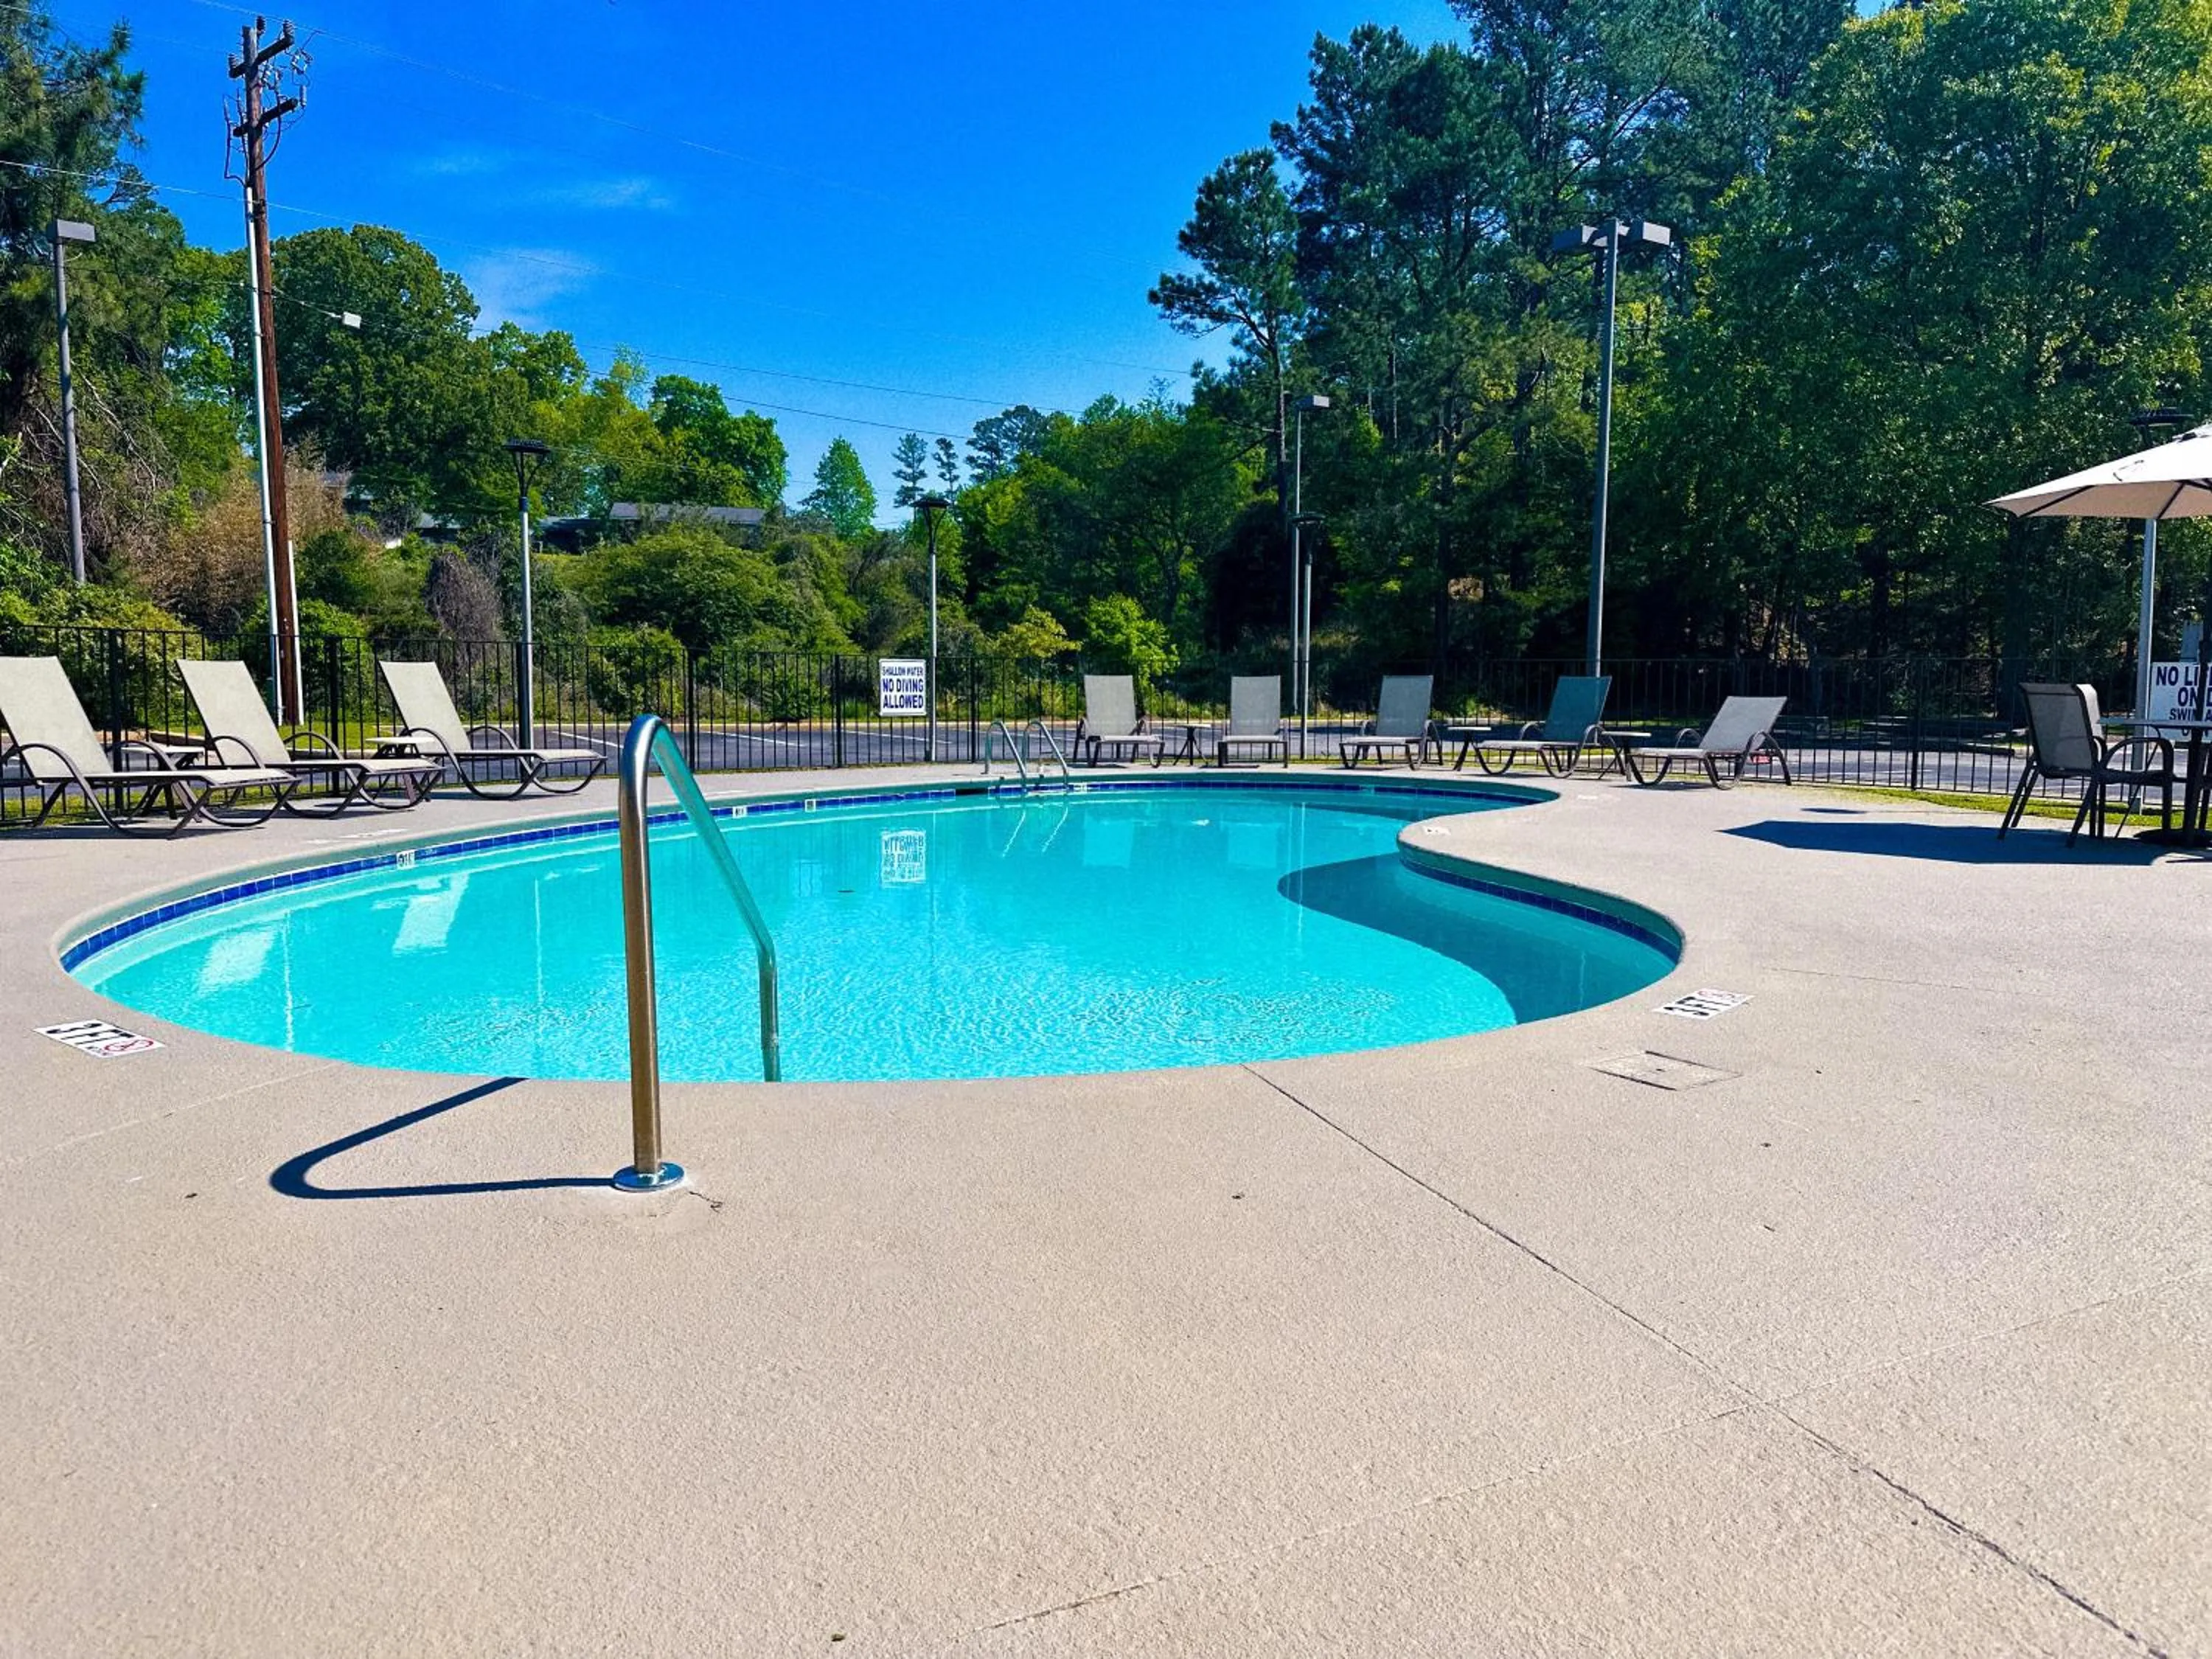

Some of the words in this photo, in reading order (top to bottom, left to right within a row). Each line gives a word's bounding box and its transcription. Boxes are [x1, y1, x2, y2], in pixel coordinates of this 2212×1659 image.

[2155, 666, 2179, 686] NO
[883, 678, 894, 692] NO
[896, 678, 924, 692] DIVING
[883, 695, 924, 708] ALLOWED
[2168, 708, 2199, 720] SWI
